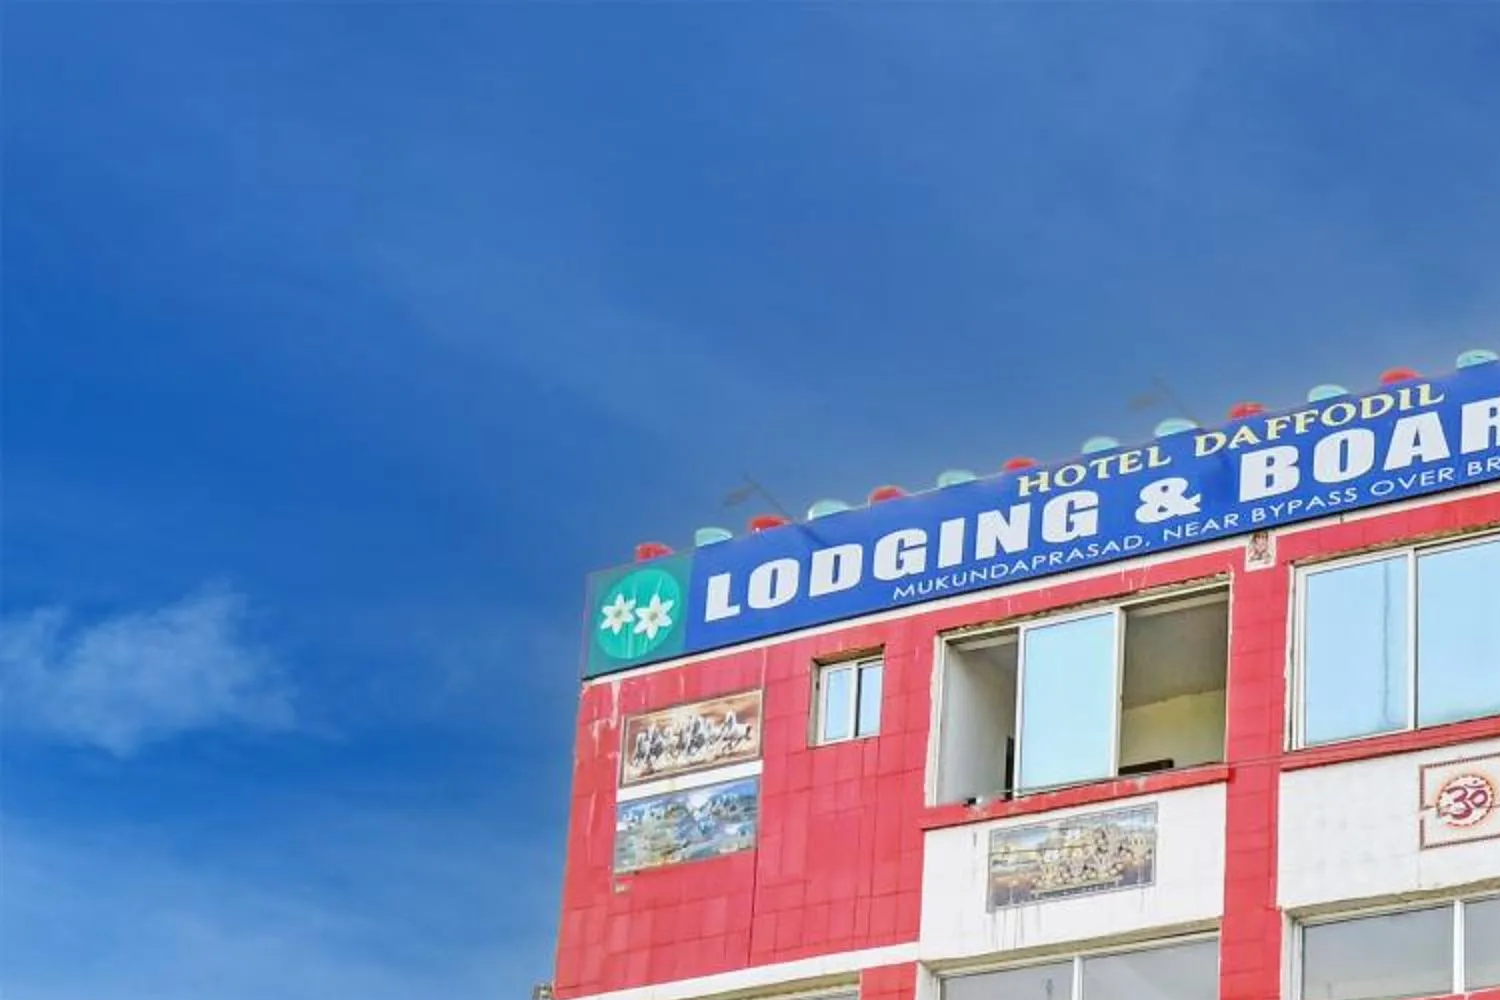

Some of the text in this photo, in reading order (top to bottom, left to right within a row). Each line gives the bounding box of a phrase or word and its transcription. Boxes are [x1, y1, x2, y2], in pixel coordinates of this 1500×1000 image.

[1018, 383, 1445, 497] HOTEL DAFFODIL
[705, 490, 1099, 622] LODGING
[1135, 477, 1201, 524] &
[1163, 513, 1239, 541] NEAR
[1251, 487, 1360, 525] BYPASS
[1370, 465, 1455, 498] OVER
